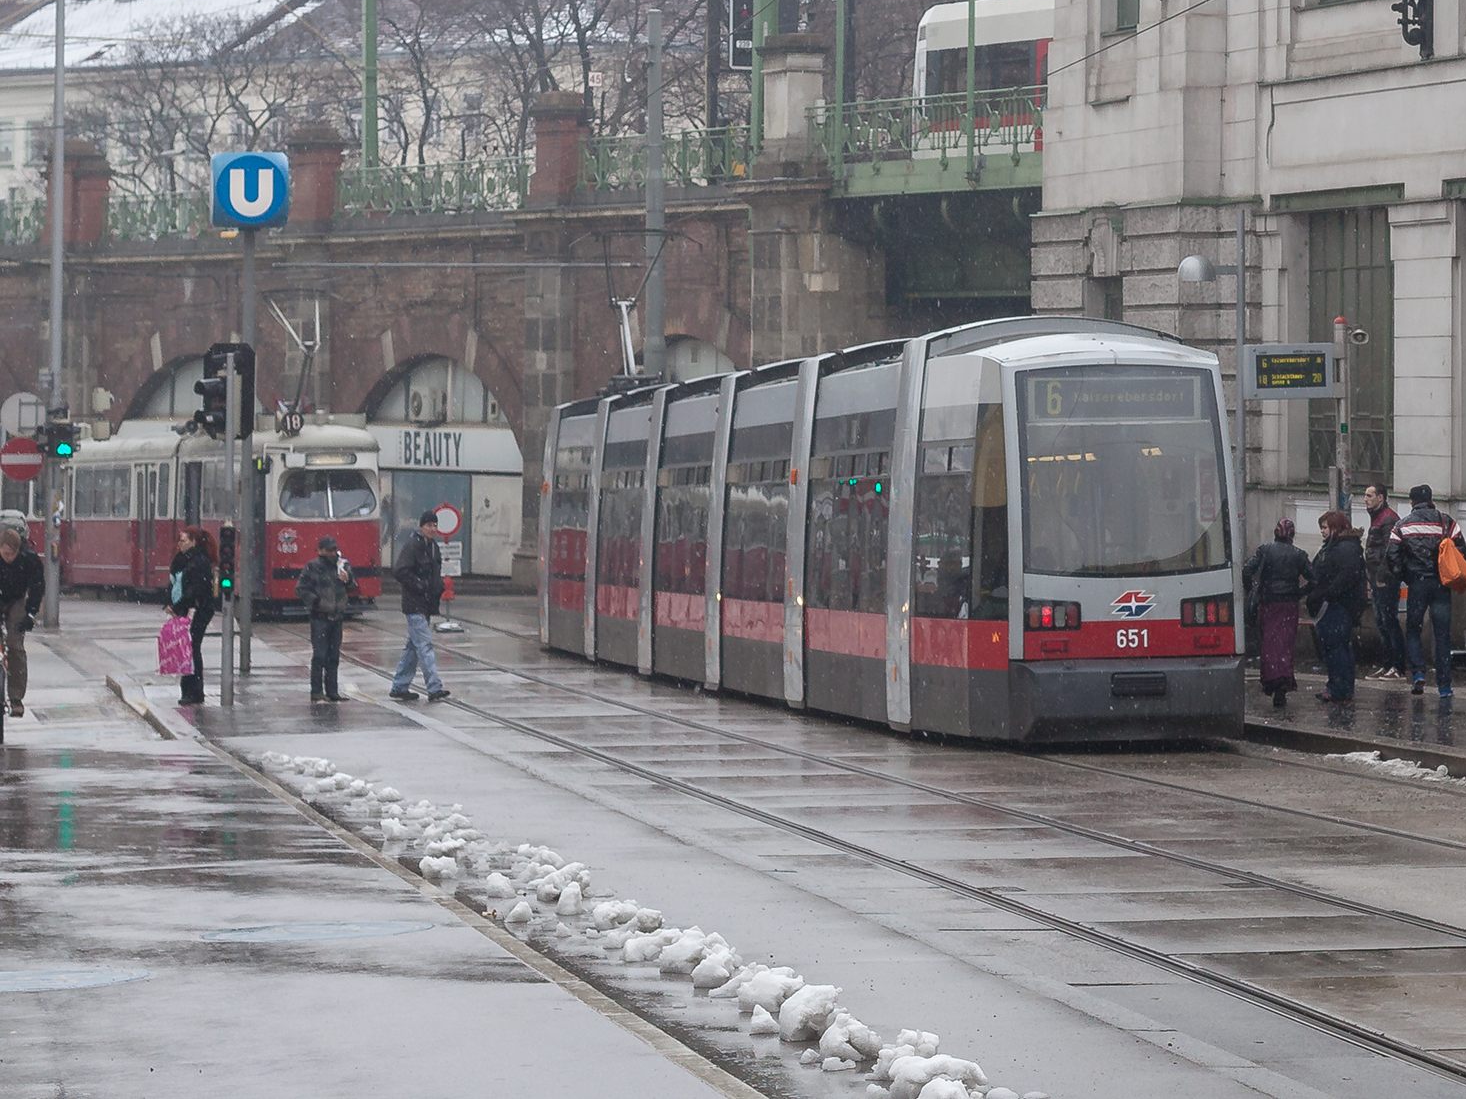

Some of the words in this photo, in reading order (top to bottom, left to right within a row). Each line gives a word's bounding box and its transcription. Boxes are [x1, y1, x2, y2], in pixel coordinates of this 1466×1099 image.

[229, 168, 274, 217] U
[1046, 380, 1062, 415] 6
[286, 414, 301, 430] 18
[403, 431, 462, 467] BEAUTY
[1116, 628, 1149, 648] 651
